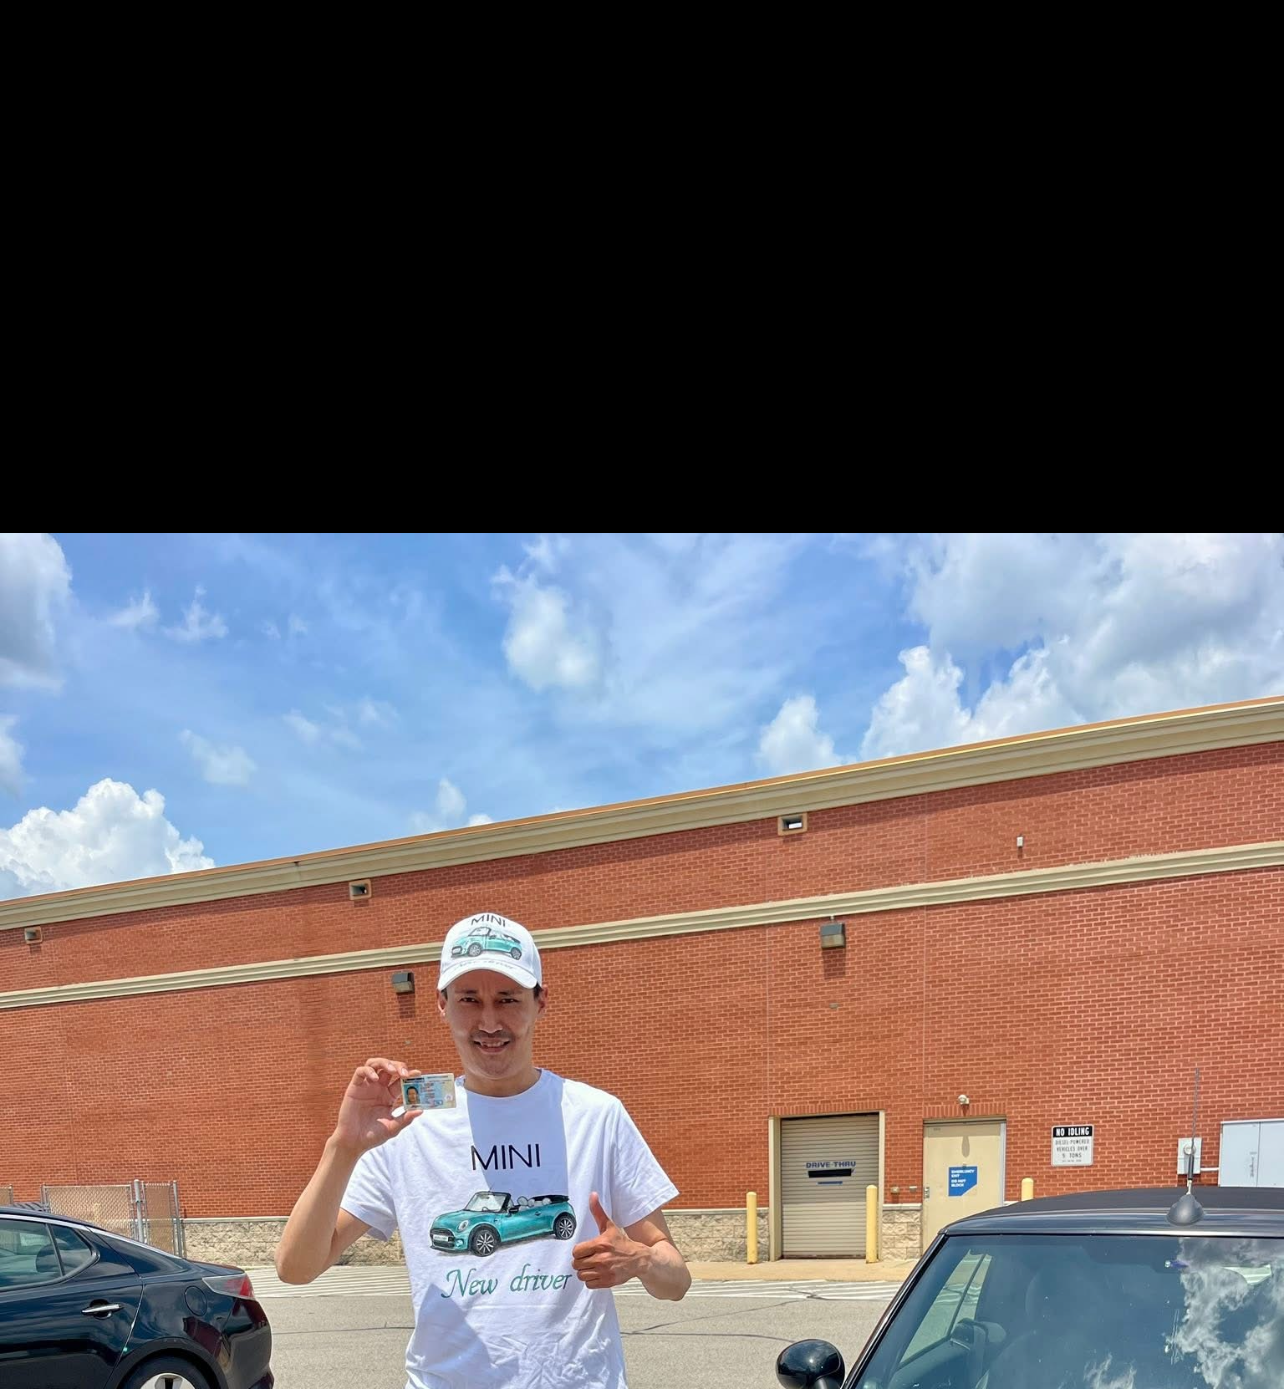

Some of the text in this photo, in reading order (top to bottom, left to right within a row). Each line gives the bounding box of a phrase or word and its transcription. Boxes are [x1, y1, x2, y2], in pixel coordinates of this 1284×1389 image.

[471, 914, 506, 927] MINI
[1056, 1127, 1090, 1136] NO IDLING
[470, 1143, 541, 1171] MINI
[441, 1263, 573, 1299] New driver
